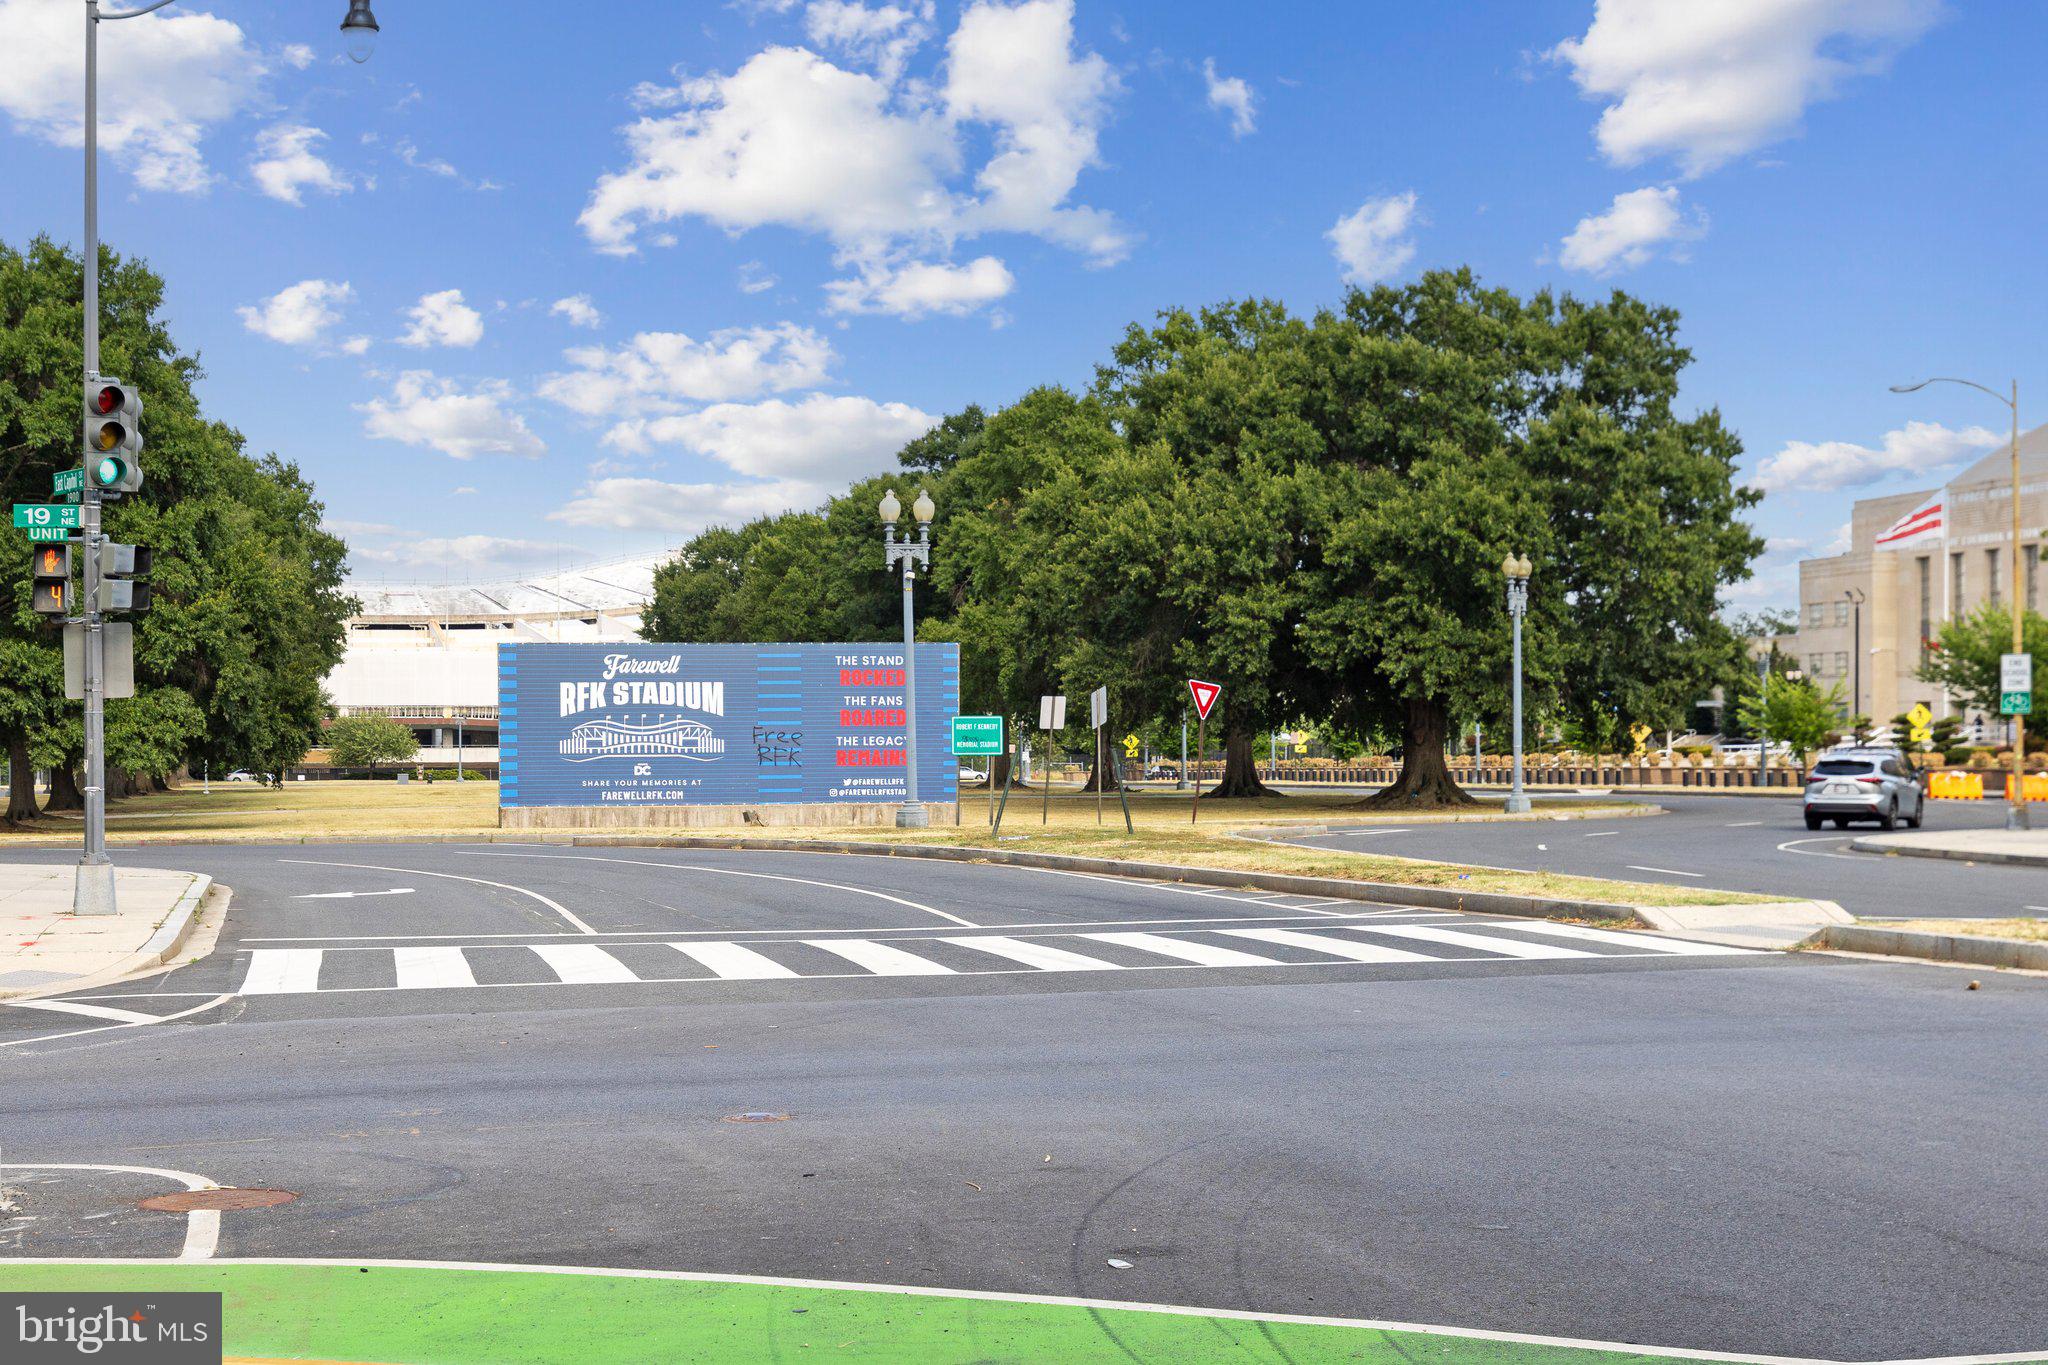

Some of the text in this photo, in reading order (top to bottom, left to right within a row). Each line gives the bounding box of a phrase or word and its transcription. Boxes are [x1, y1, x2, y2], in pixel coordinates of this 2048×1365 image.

[23, 507, 51, 525] 19
[61, 508, 75, 516] ST
[61, 517, 75, 525] NE
[30, 528, 67, 539] UNIT
[51, 585, 62, 608] 4
[835, 656, 904, 666] THE STAND
[602, 654, 682, 680] Farewell
[840, 669, 906, 687] ROCKED
[559, 681, 724, 717] RFK STADIUM
[844, 696, 903, 706] THE FANS
[840, 709, 907, 727] ROARED
[752, 726, 803, 747] Free
[836, 736, 907, 746] THE LEGAC
[758, 744, 802, 767] RFK
[633, 765, 652, 776] DC
[852, 778, 904, 786] @FAREWELLRFK
[601, 790, 684, 801] FAREWELLRFK.COM
